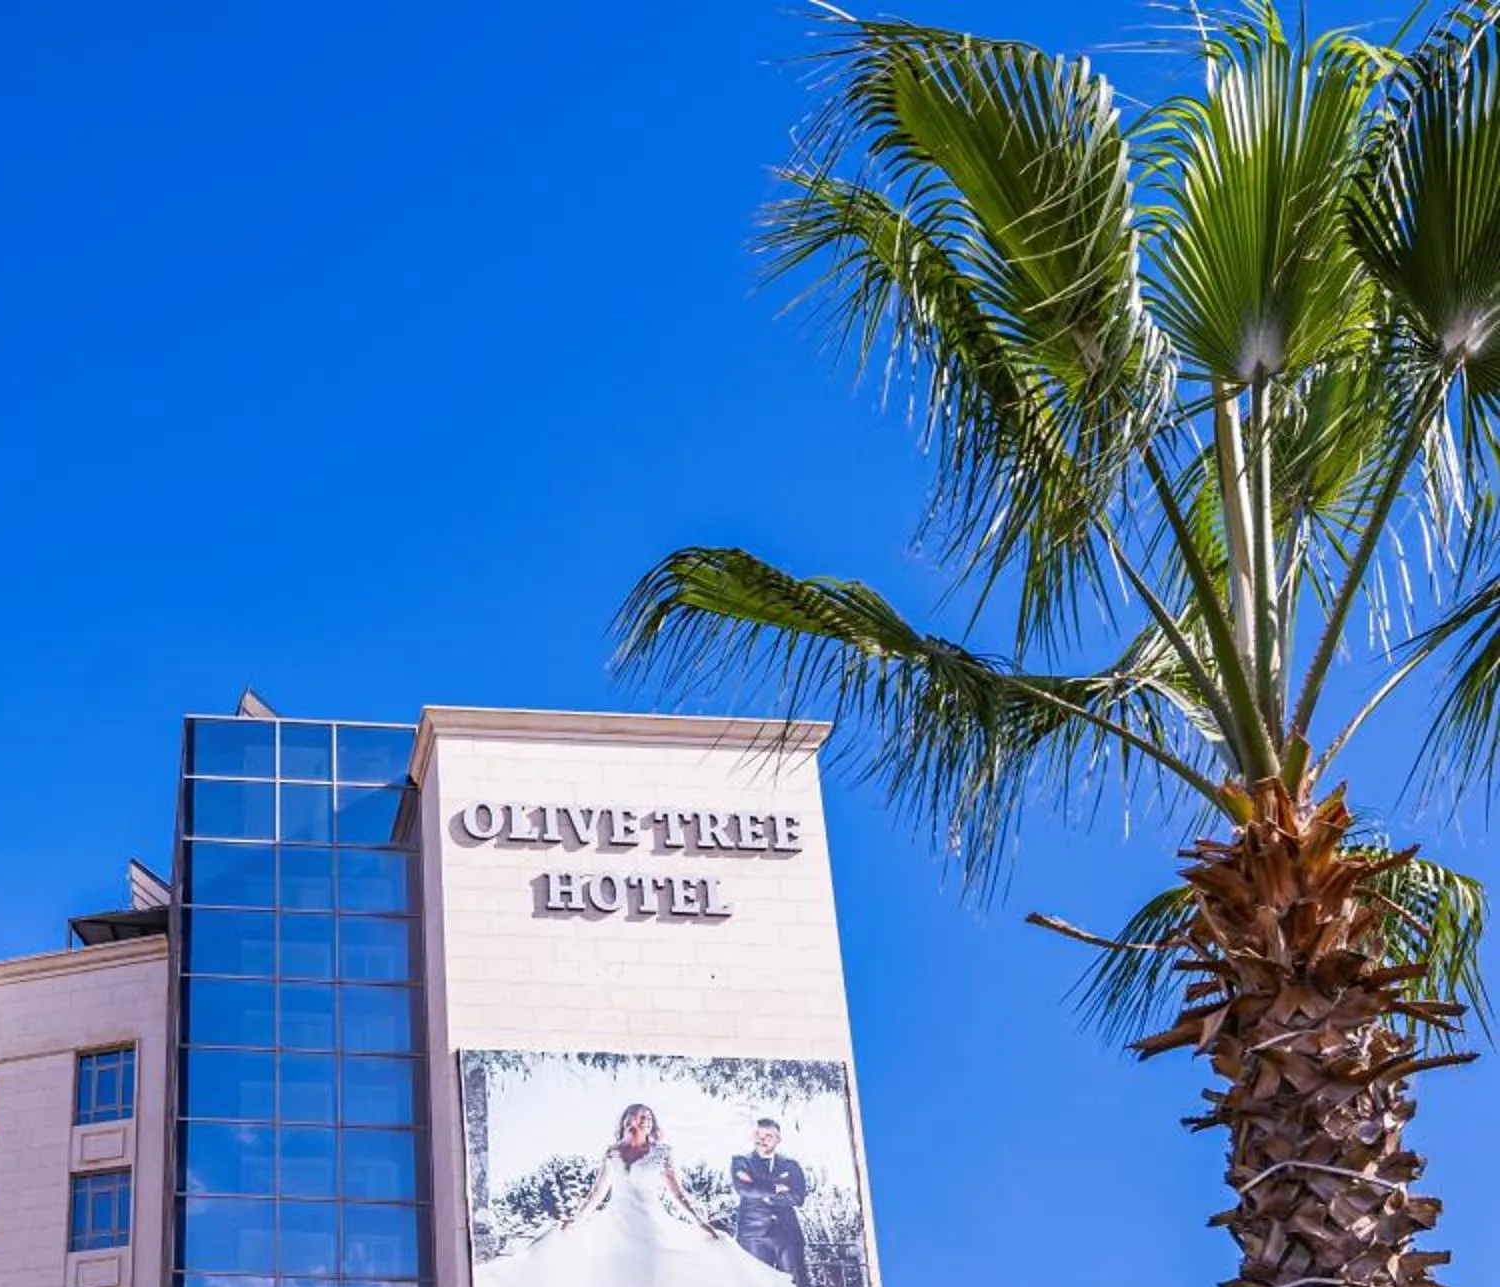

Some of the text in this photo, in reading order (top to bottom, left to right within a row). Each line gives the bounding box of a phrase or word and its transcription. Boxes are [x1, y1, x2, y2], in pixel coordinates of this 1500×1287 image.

[462, 801, 802, 853] OLIVE TREE
[543, 873, 733, 917] HOTEL
